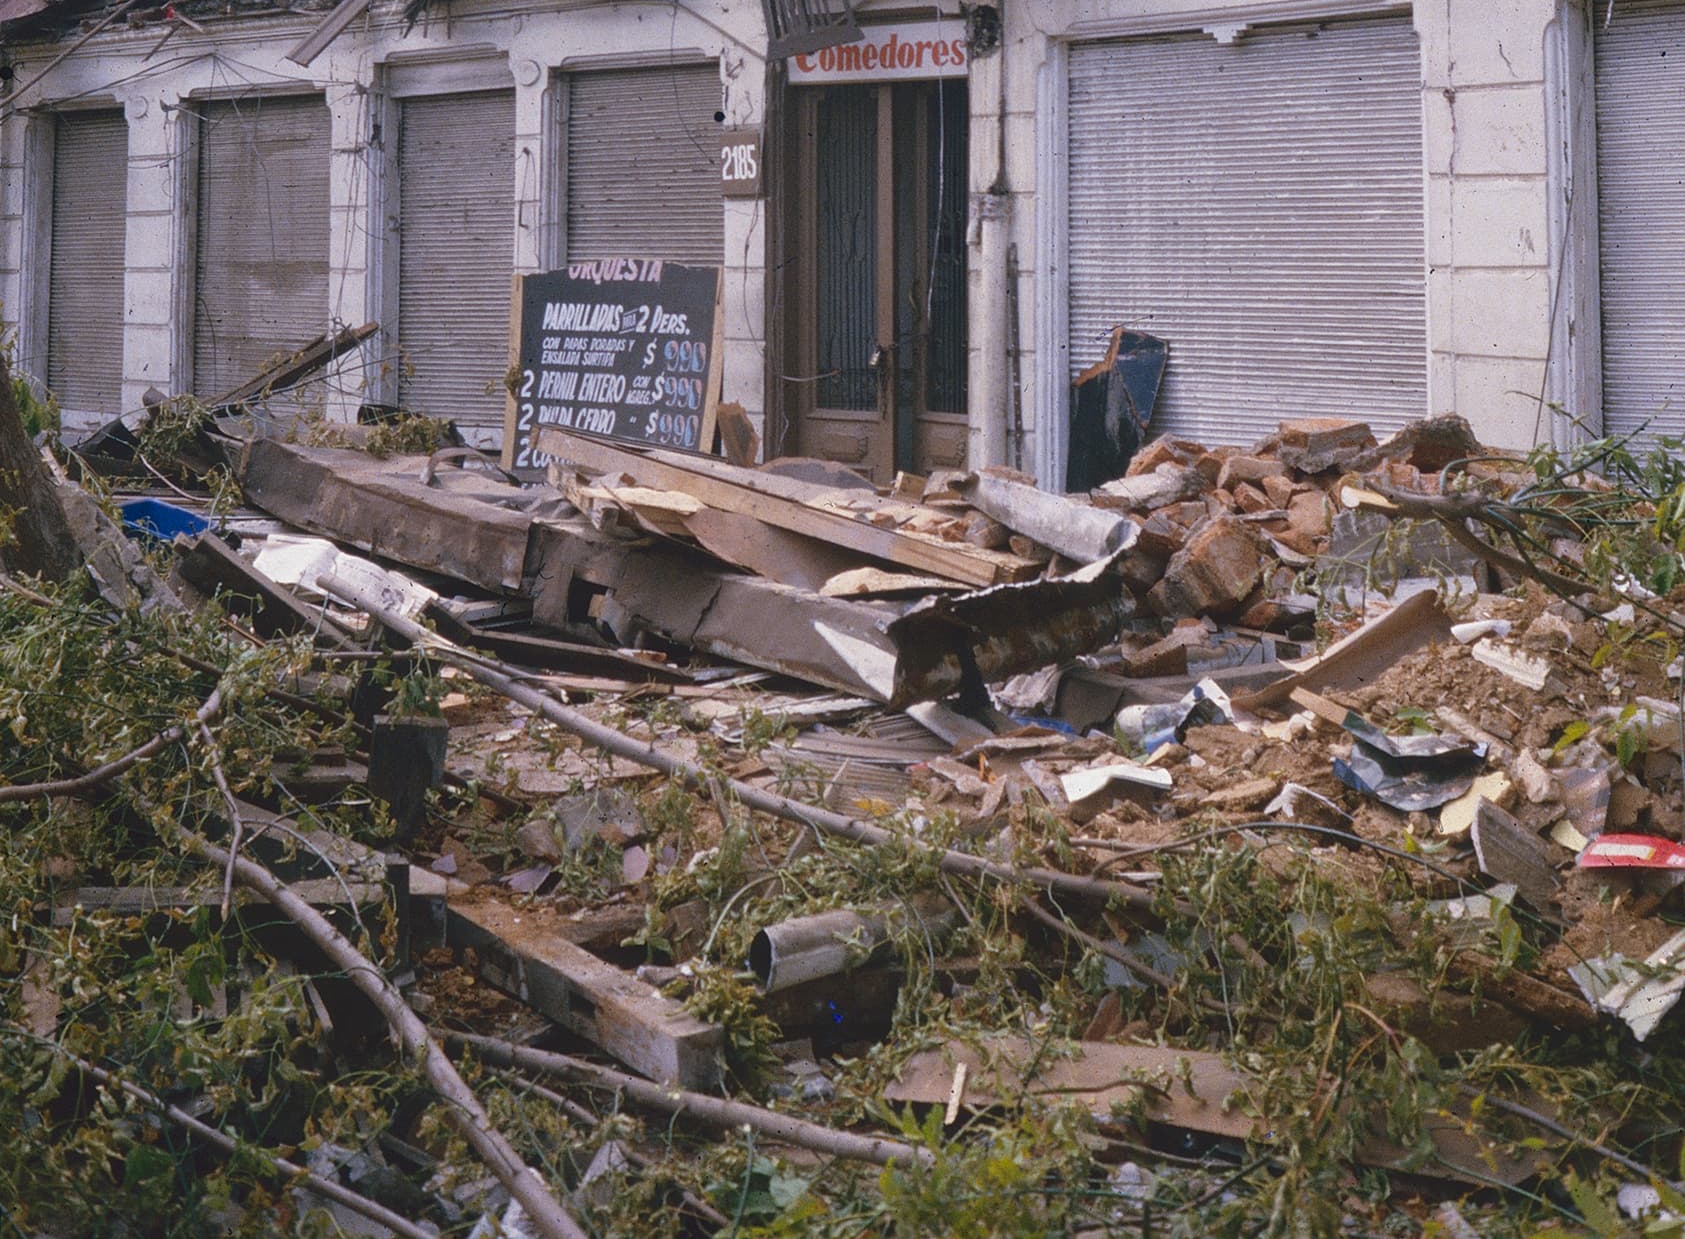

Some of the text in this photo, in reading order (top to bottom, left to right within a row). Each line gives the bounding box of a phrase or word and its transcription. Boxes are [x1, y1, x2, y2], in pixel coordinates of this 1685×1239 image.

[721, 144, 757, 181] 2185
[542, 302, 624, 332] PARRILLADAS
[636, 305, 650, 333] 2
[541, 351, 616, 367] ENSALADA SURTIDA
[542, 337, 636, 353] CON PAPAS DORADAS Y
[521, 369, 626, 403] 2 PERNIL ENTERO
[632, 376, 652, 388] CON
[518, 403, 534, 431] 2
